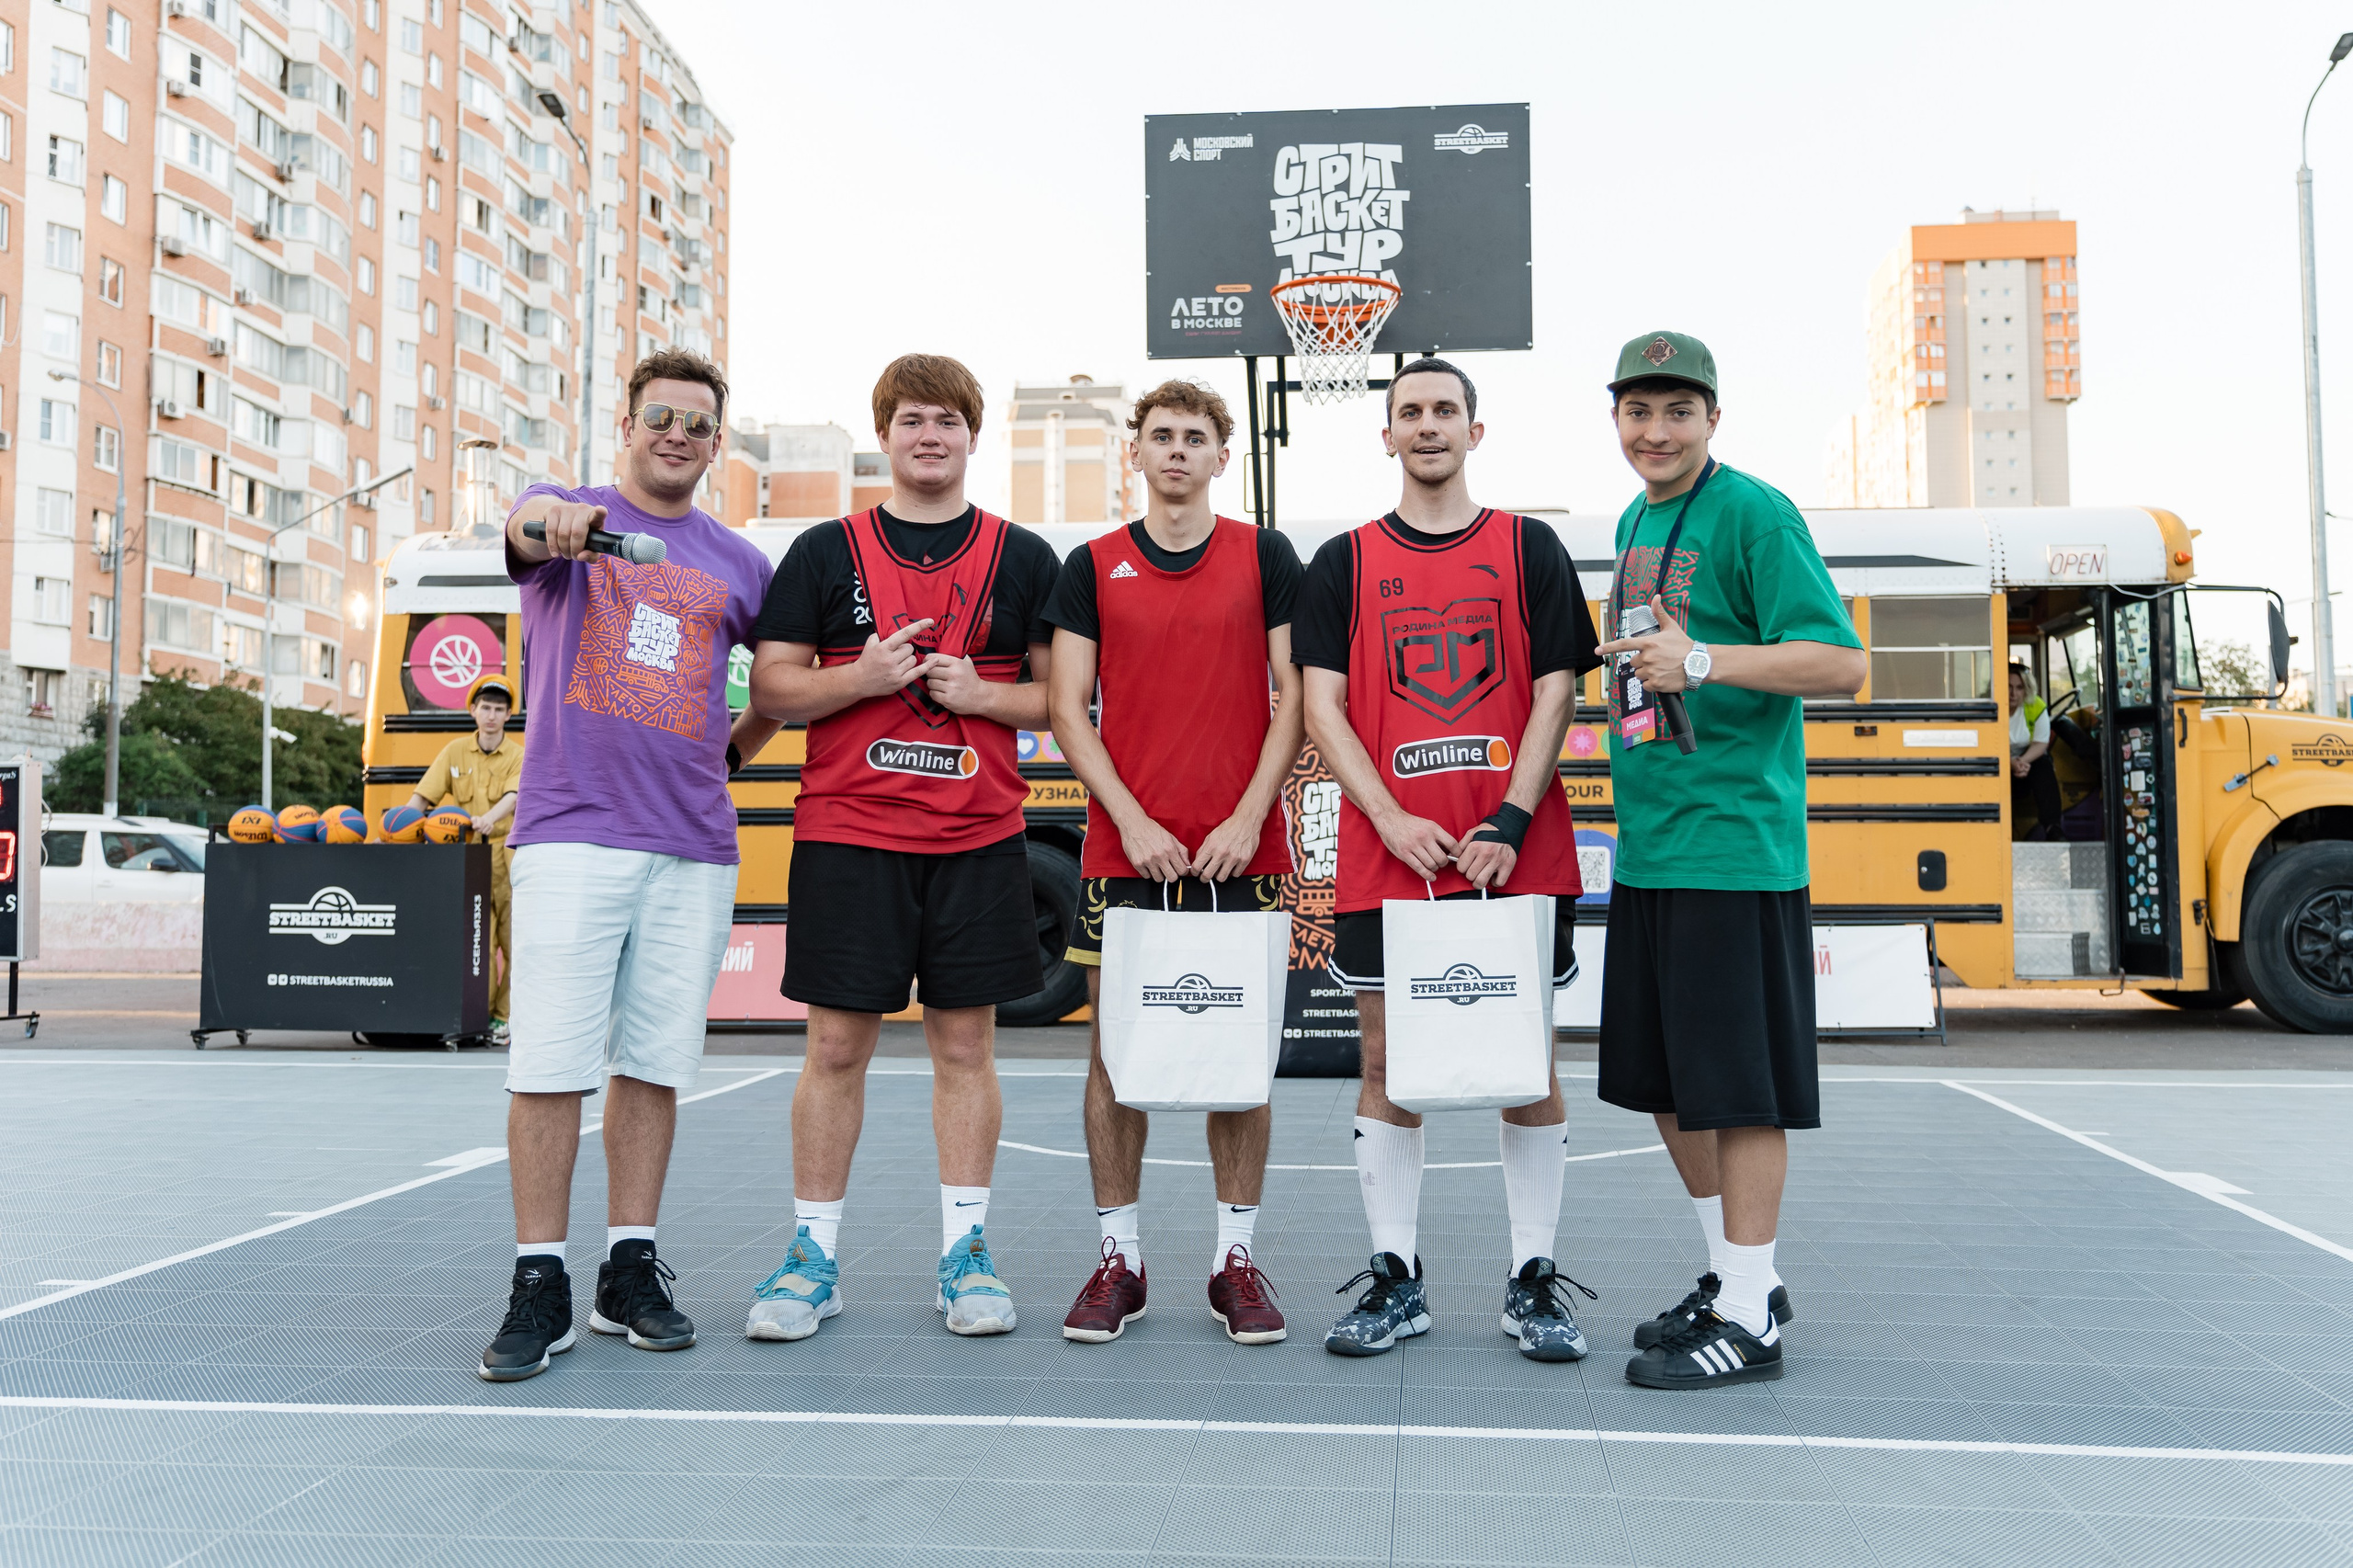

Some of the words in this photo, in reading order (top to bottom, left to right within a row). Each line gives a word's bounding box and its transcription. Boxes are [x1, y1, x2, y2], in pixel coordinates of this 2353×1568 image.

[1193, 133, 1254, 149] МОСКОВСКИЙ
[1434, 136, 1508, 146] STREETBASKET
[1193, 149, 1222, 161] СПОРТ
[1273, 142, 1404, 198] СТРИТ
[1269, 188, 1410, 244] БАСКЕТ
[1273, 229, 1404, 274] ТУР
[1170, 296, 1244, 316] ЛЕТО
[1171, 318, 1181, 329] В
[1184, 317, 1242, 329] МОСКВЕ
[2050, 553, 2105, 575] OPEN
[1109, 570, 1138, 579] adidas
[648, 589, 666, 602] STOP
[1379, 577, 1404, 598] 69
[634, 602, 680, 632] СТРИТ
[1392, 620, 1446, 635] РОДИНА
[1447, 615, 1494, 627] МЕДИА
[628, 620, 682, 648] БАСКЕТ
[629, 637, 678, 658] ТУР
[626, 647, 676, 672] МОСКВА
[611, 689, 642, 713] ЛЕТО
[1626, 716, 1648, 731] МЕДИА
[880, 745, 955, 771] Winline
[1400, 745, 1483, 770] Winline
[1564, 785, 1604, 798] OUR
[269, 912, 396, 926] STREETBASKET
[1295, 927, 1336, 955] ЛЕТ
[290, 975, 394, 986] STREETBASKETRUSSIA
[1411, 981, 1517, 994] STREETBASKET
[1142, 992, 1244, 1002] STREETBASKET
[1310, 989, 1357, 997] SPORT.MO
[1302, 1009, 1359, 1017] STREETBASK
[1303, 1029, 1362, 1038] STREETBASK
